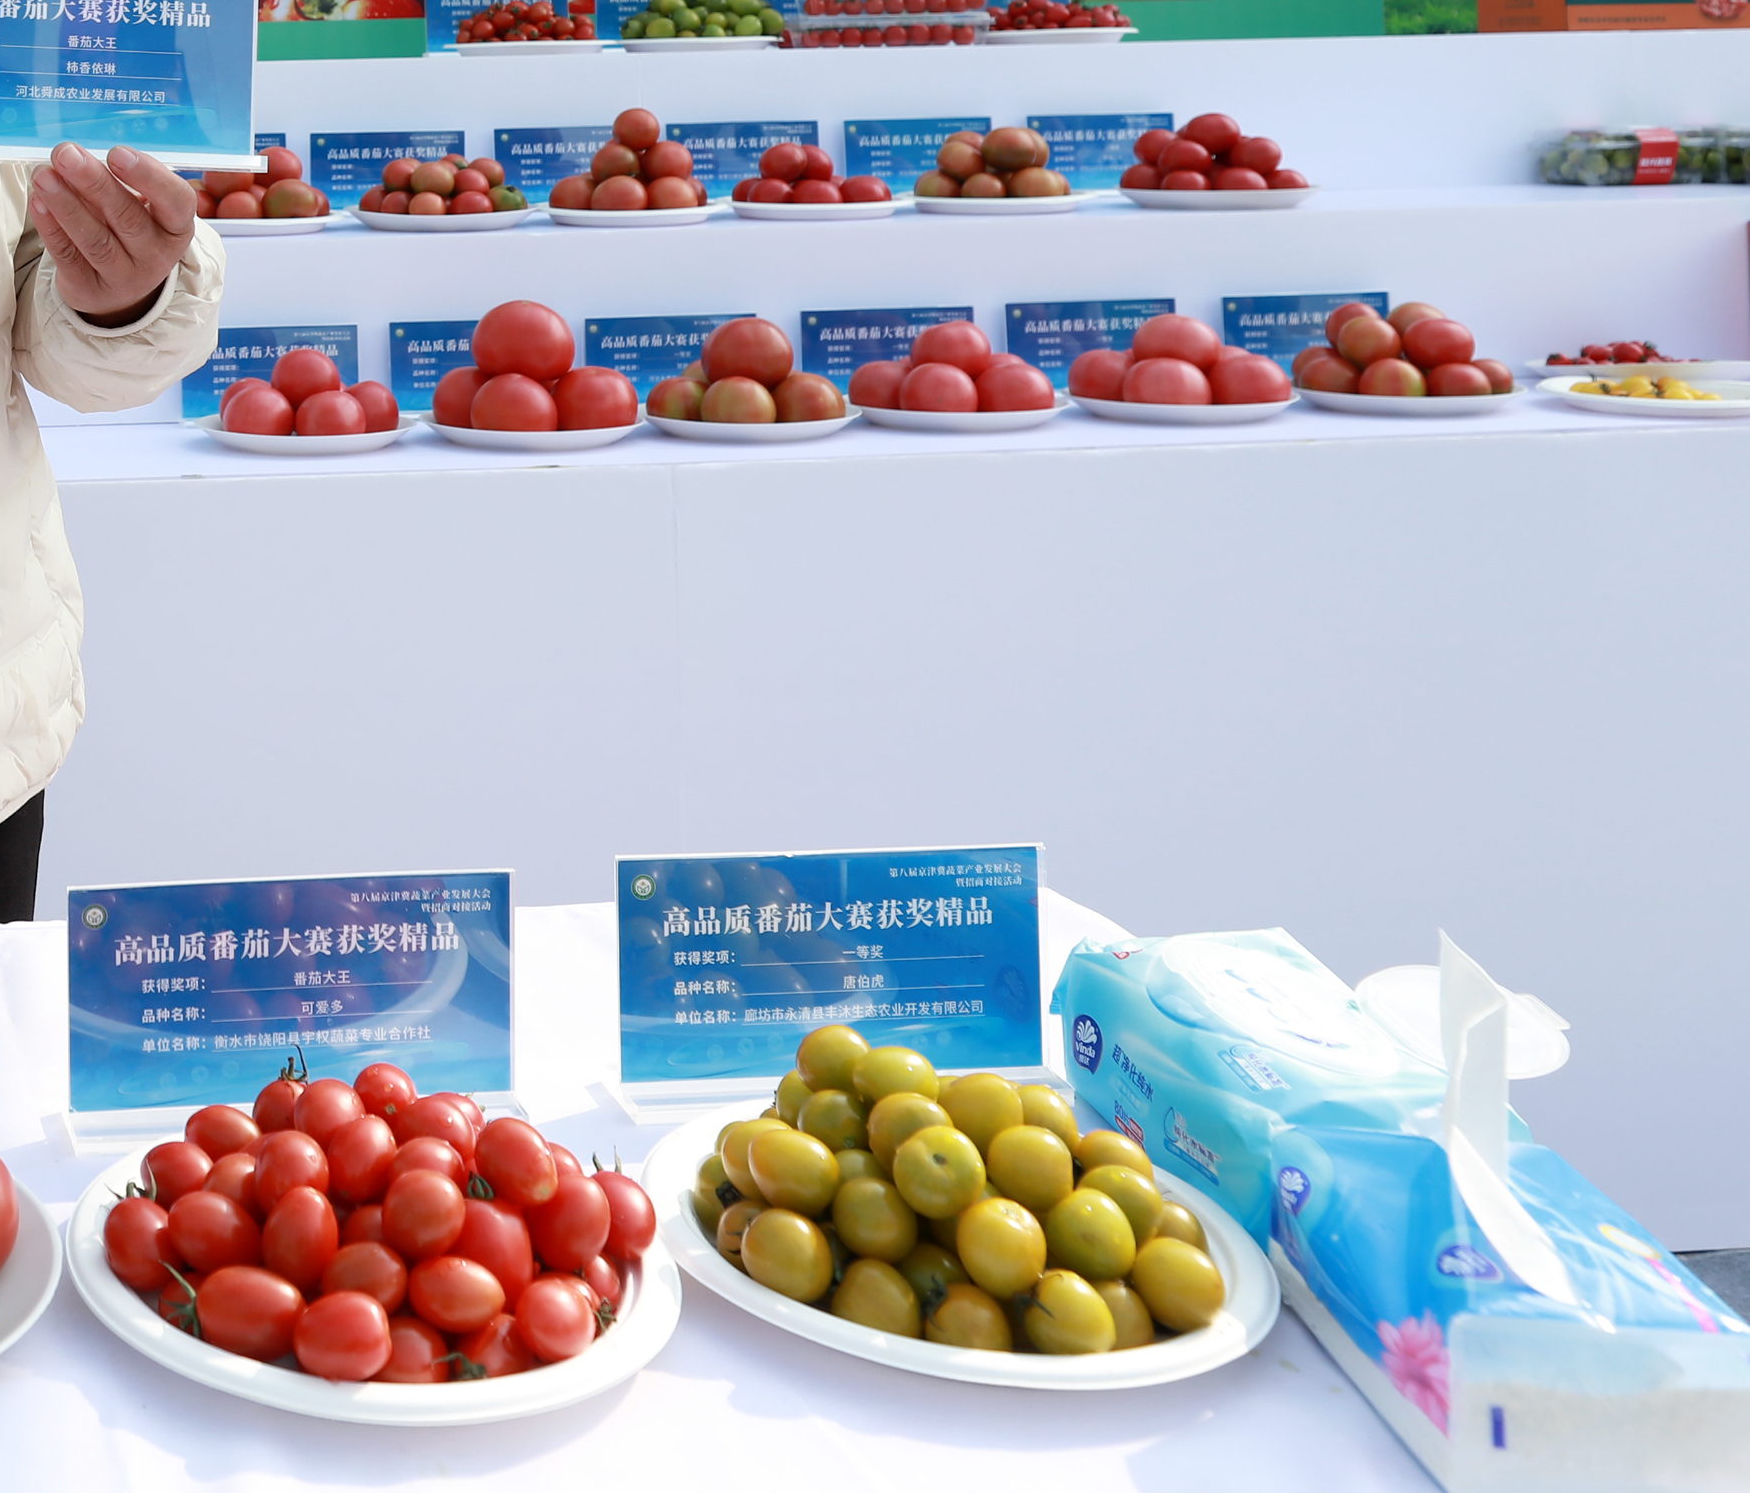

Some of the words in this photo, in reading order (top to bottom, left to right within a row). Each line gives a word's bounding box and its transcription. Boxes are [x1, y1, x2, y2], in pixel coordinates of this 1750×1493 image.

[67, 35, 117, 49] 番茄大王
[66, 60, 117, 75] 柿香依琳
[15, 84, 166, 103] 河北舜成农业发展有限公司
[859, 133, 952, 147] 高品质番茄大赛获
[407, 338, 470, 354] 高品质番茄
[889, 863, 1022, 877] 第八届京津冀蔬菜产业发展大会
[955, 876, 1022, 888] 暨招商对接活动
[350, 888, 492, 903] 第八届京津冀蔬菜产业发展大会
[662, 896, 994, 937] 高品质番茄大赛获奖精品
[114, 921, 460, 966] 高品质番茄大赛获奖精品
[674, 951, 736, 966] 获得奖项：
[843, 945, 884, 960] 一等奖
[141, 977, 206, 995] 获得奖项：
[294, 970, 351, 986] 番茄大王
[674, 980, 736, 996] 品种名称：
[843, 974, 885, 990] 唐伯虎
[142, 1007, 206, 1024] 品种名称：
[301, 999, 344, 1015] 可爱多
[674, 1010, 737, 1026] 单位名称：
[142, 1035, 207, 1053] 单位名称：
[214, 1025, 431, 1050] 衡水市饶阳县宇权蔬菜专业合作社
[1075, 1041, 1095, 1059] Vinda
